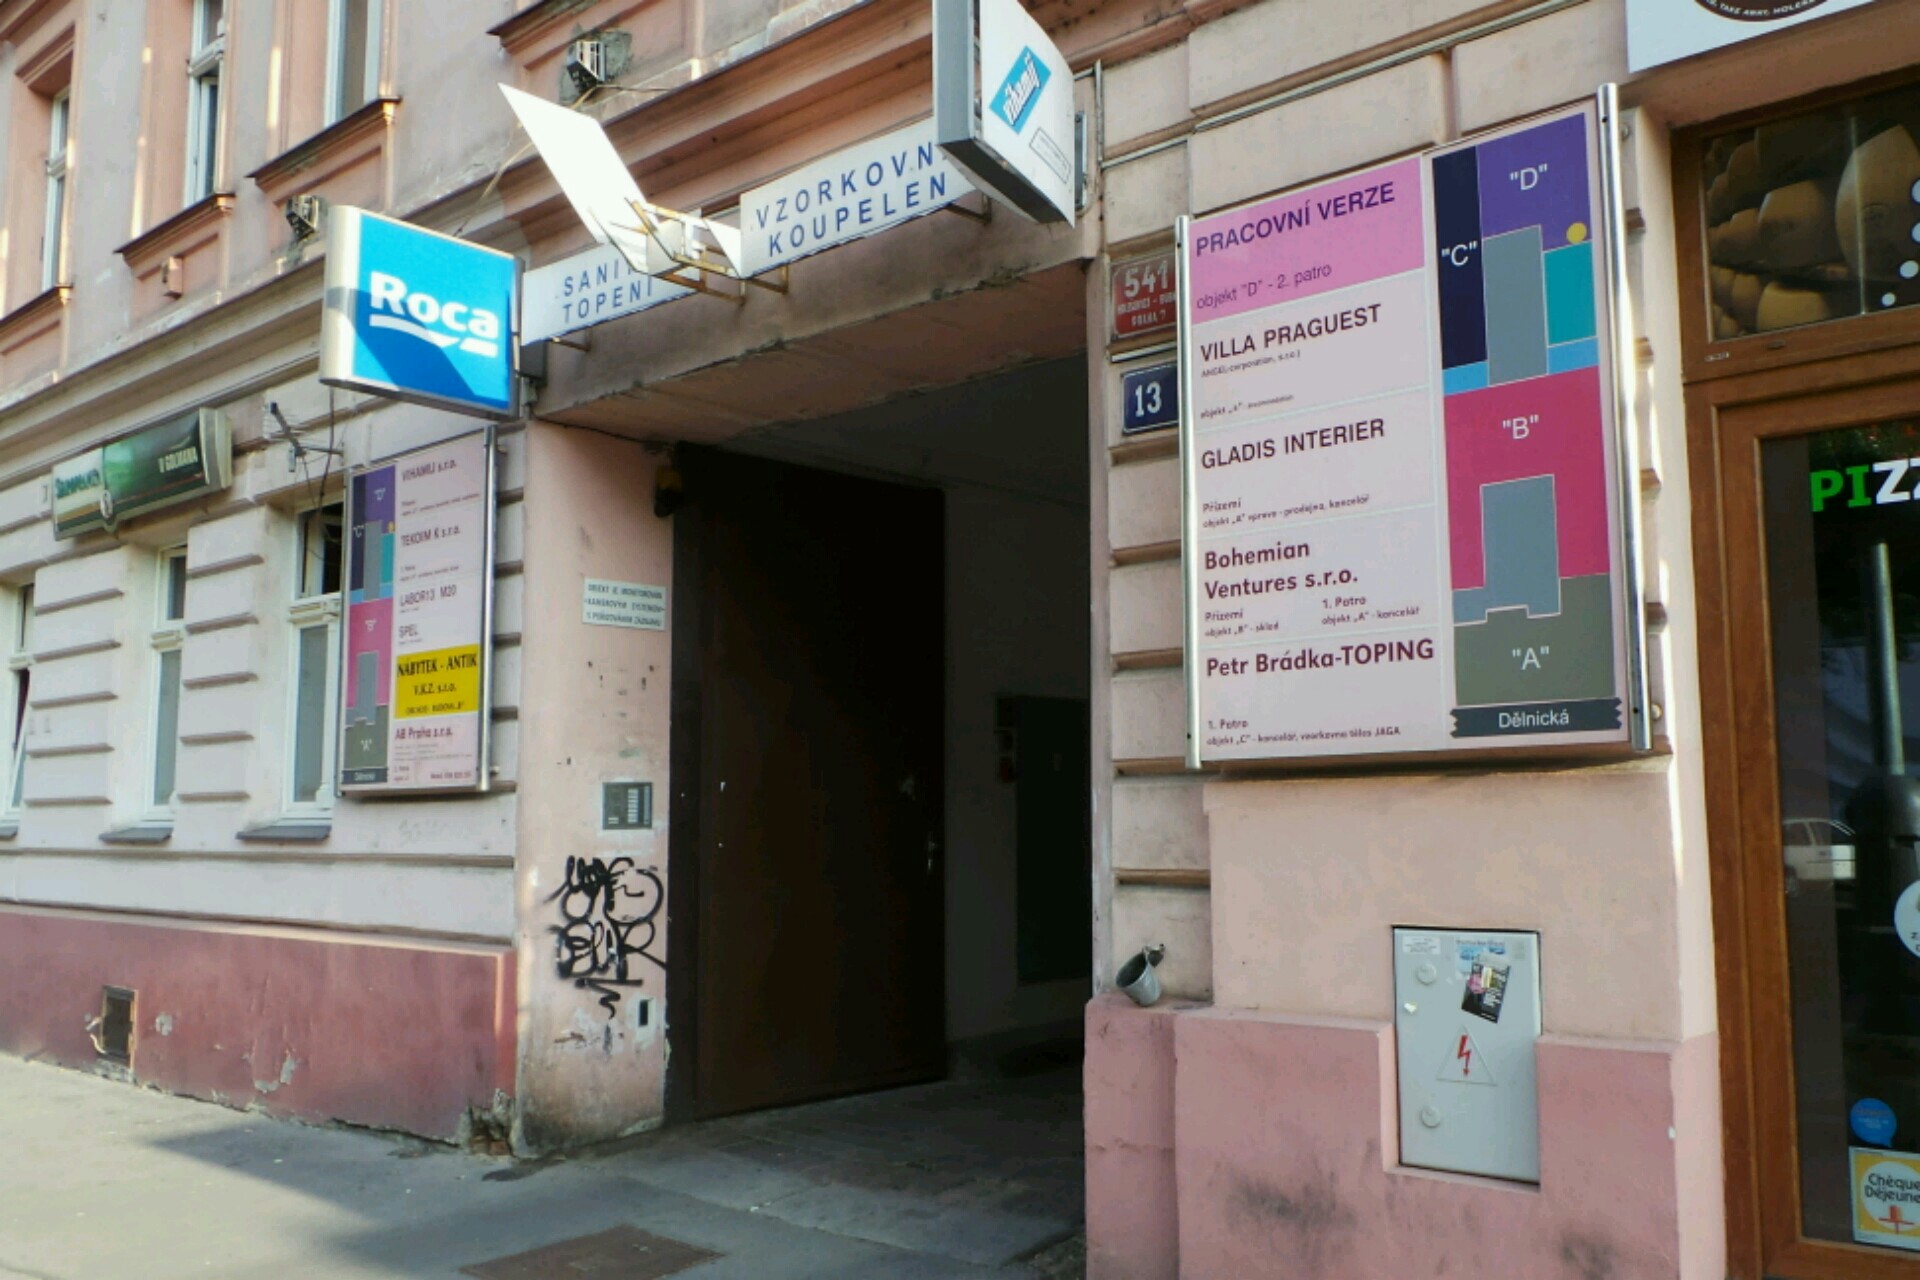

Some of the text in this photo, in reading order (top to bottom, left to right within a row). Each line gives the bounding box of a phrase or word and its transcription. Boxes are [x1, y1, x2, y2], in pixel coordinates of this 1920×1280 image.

[755, 141, 934, 230] VZORKOVN
[769, 172, 946, 258] KOUPELEN
[1196, 181, 1396, 257] PRACOVNÍ VERZE
[563, 258, 634, 297] SANI
[1124, 260, 1169, 299] 541
[1197, 287, 1238, 311] objekt
[1295, 264, 1332, 288] patro
[370, 270, 499, 340] Roca
[1200, 303, 1382, 363] VILLA PRAGUEST
[1135, 380, 1162, 418] 13
[1202, 417, 1385, 470] GLADIS INTERIER
[1810, 458, 1920, 512] PIZ
[1204, 541, 1311, 570] Bohemian
[1204, 568, 1359, 600] Ventures s.r.o.
[1206, 637, 1435, 678] Petr Brádka-TOPING
[1498, 708, 1570, 729] Dělnická
